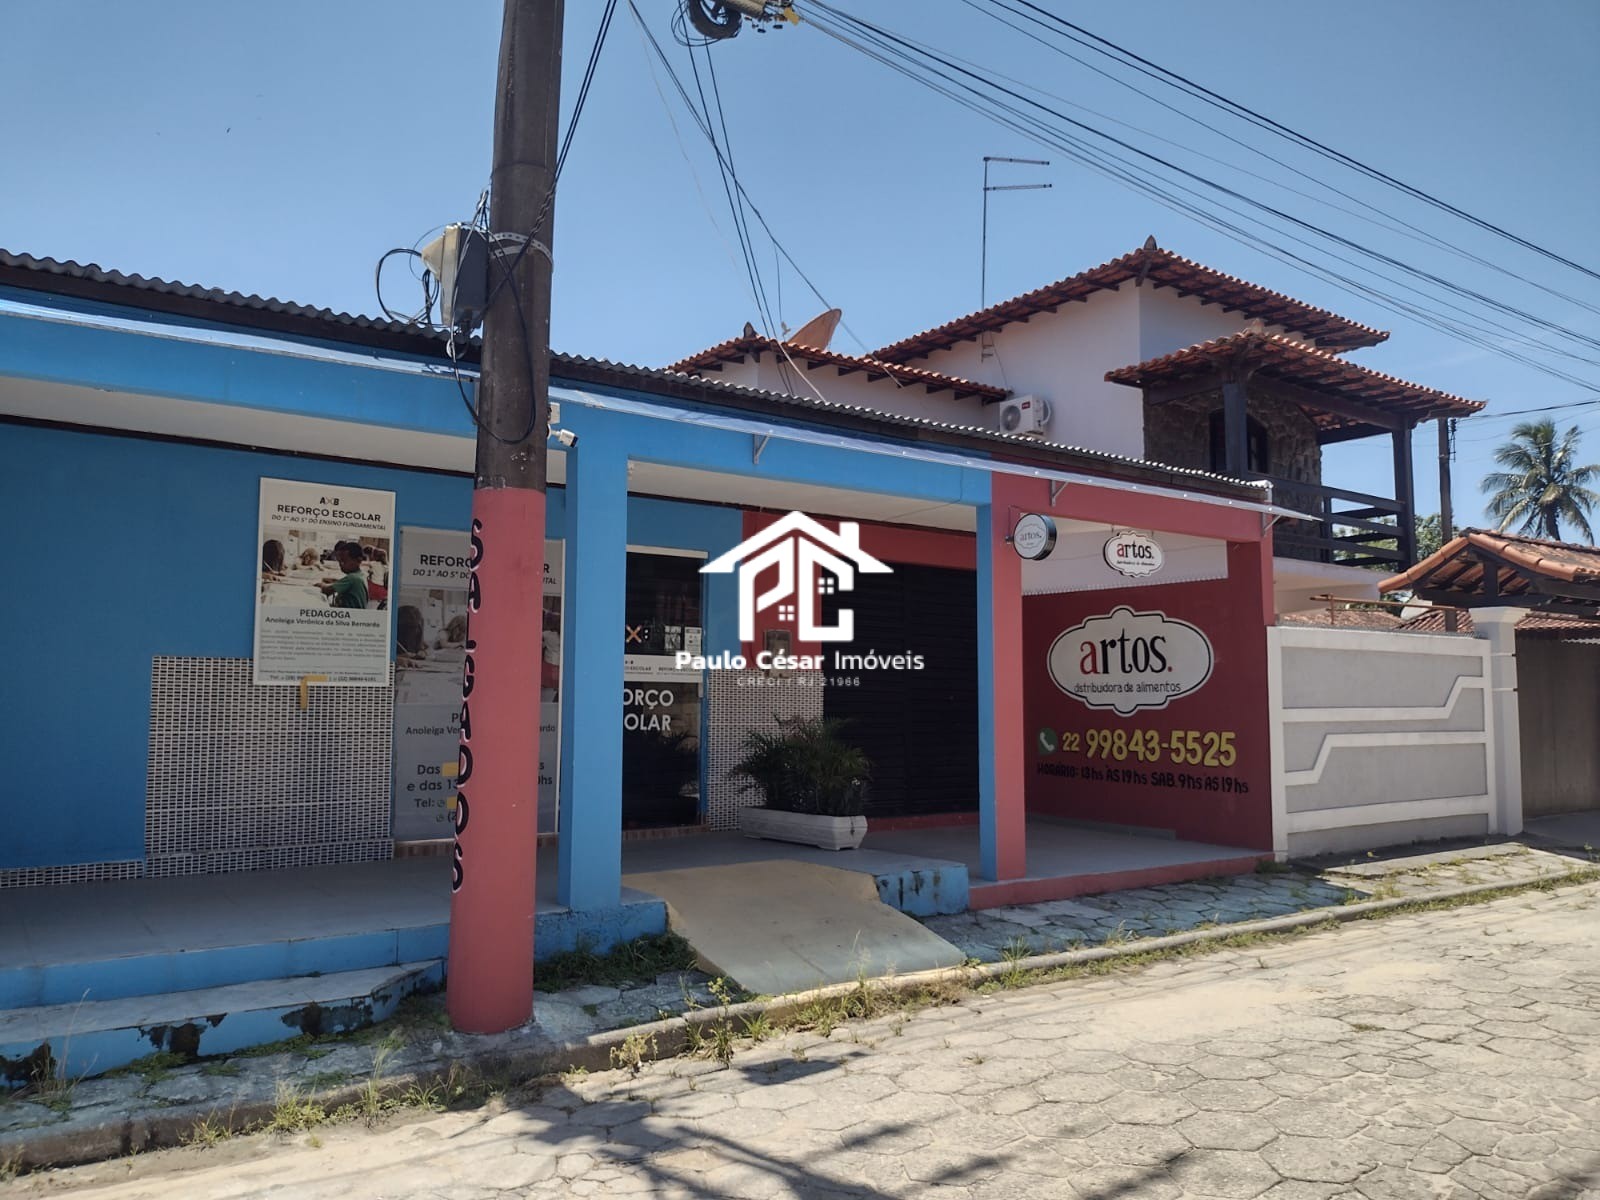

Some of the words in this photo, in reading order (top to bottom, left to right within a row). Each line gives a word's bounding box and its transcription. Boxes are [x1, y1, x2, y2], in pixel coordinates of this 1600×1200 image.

[277, 504, 329, 518] REFORÇO
[332, 510, 381, 522] ESCOLAR
[319, 519, 342, 527] ENSINO
[413, 568, 425, 577] DO
[437, 569, 449, 578] AO
[299, 608, 351, 619] PEDAGOGA
[335, 619, 350, 627] Silva
[1123, 681, 1133, 693] de
[1136, 680, 1182, 693] alimentos
[623, 689, 674, 710] ORÇO
[624, 713, 672, 731] OLAR
[1062, 732, 1081, 752] 22
[1085, 728, 1237, 767] 99843-5525
[417, 764, 441, 775] Das
[407, 783, 415, 791] e
[419, 780, 442, 791] das
[414, 798, 435, 808] Tel:
